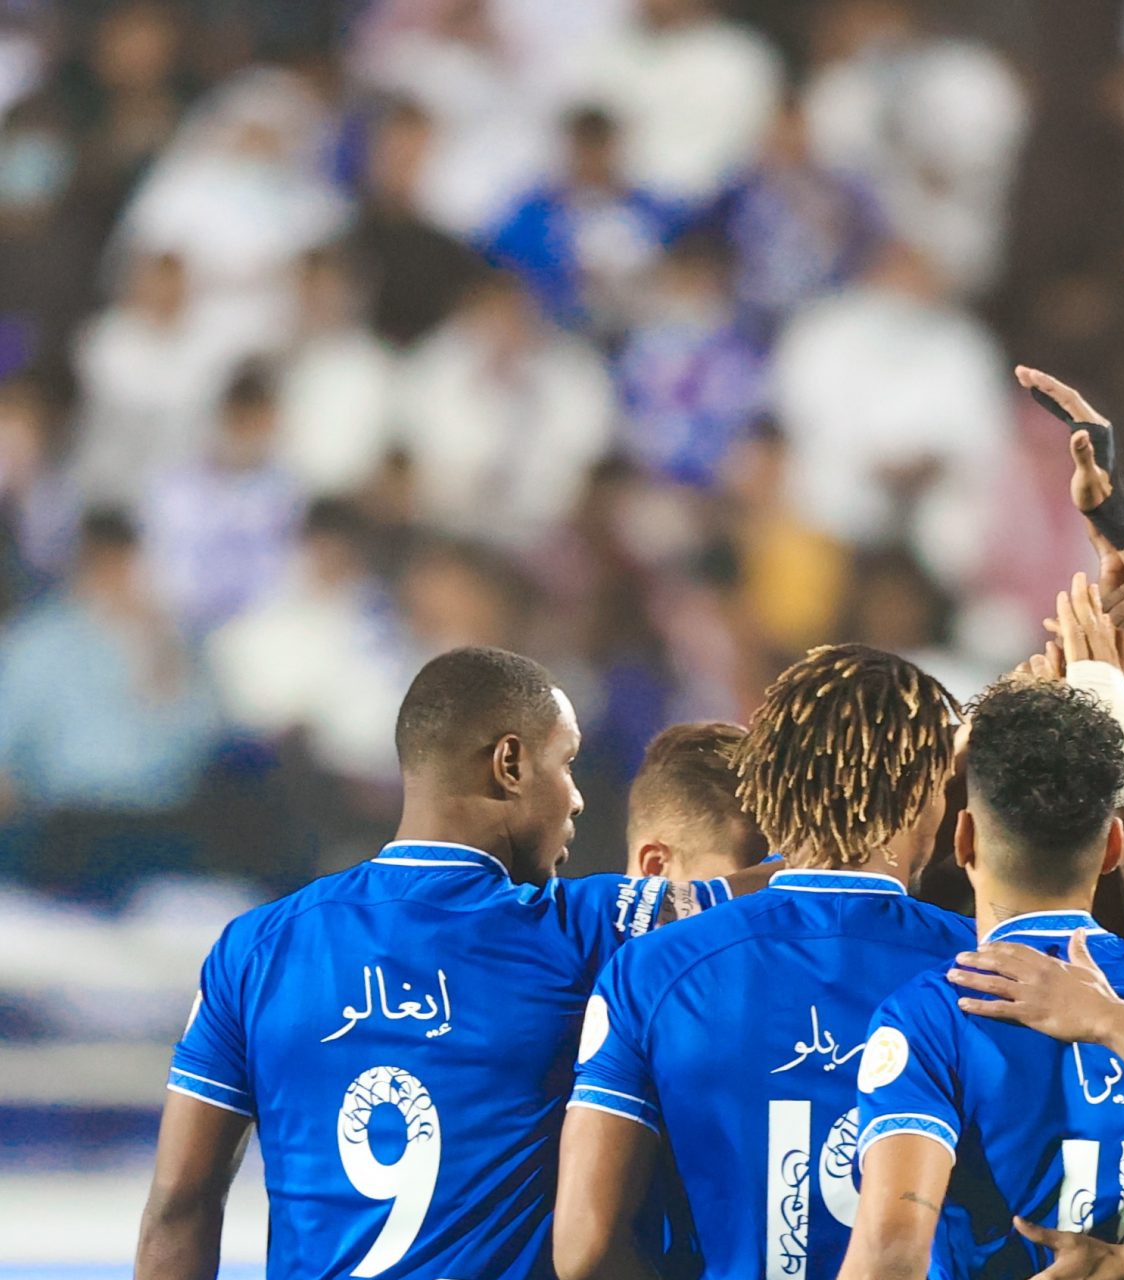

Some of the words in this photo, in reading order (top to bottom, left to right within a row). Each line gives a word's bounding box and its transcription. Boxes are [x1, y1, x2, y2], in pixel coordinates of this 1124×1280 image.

[320, 965, 452, 1043] إيغالو
[769, 1005, 867, 1073] ريلو
[337, 1065, 441, 1278] 9
